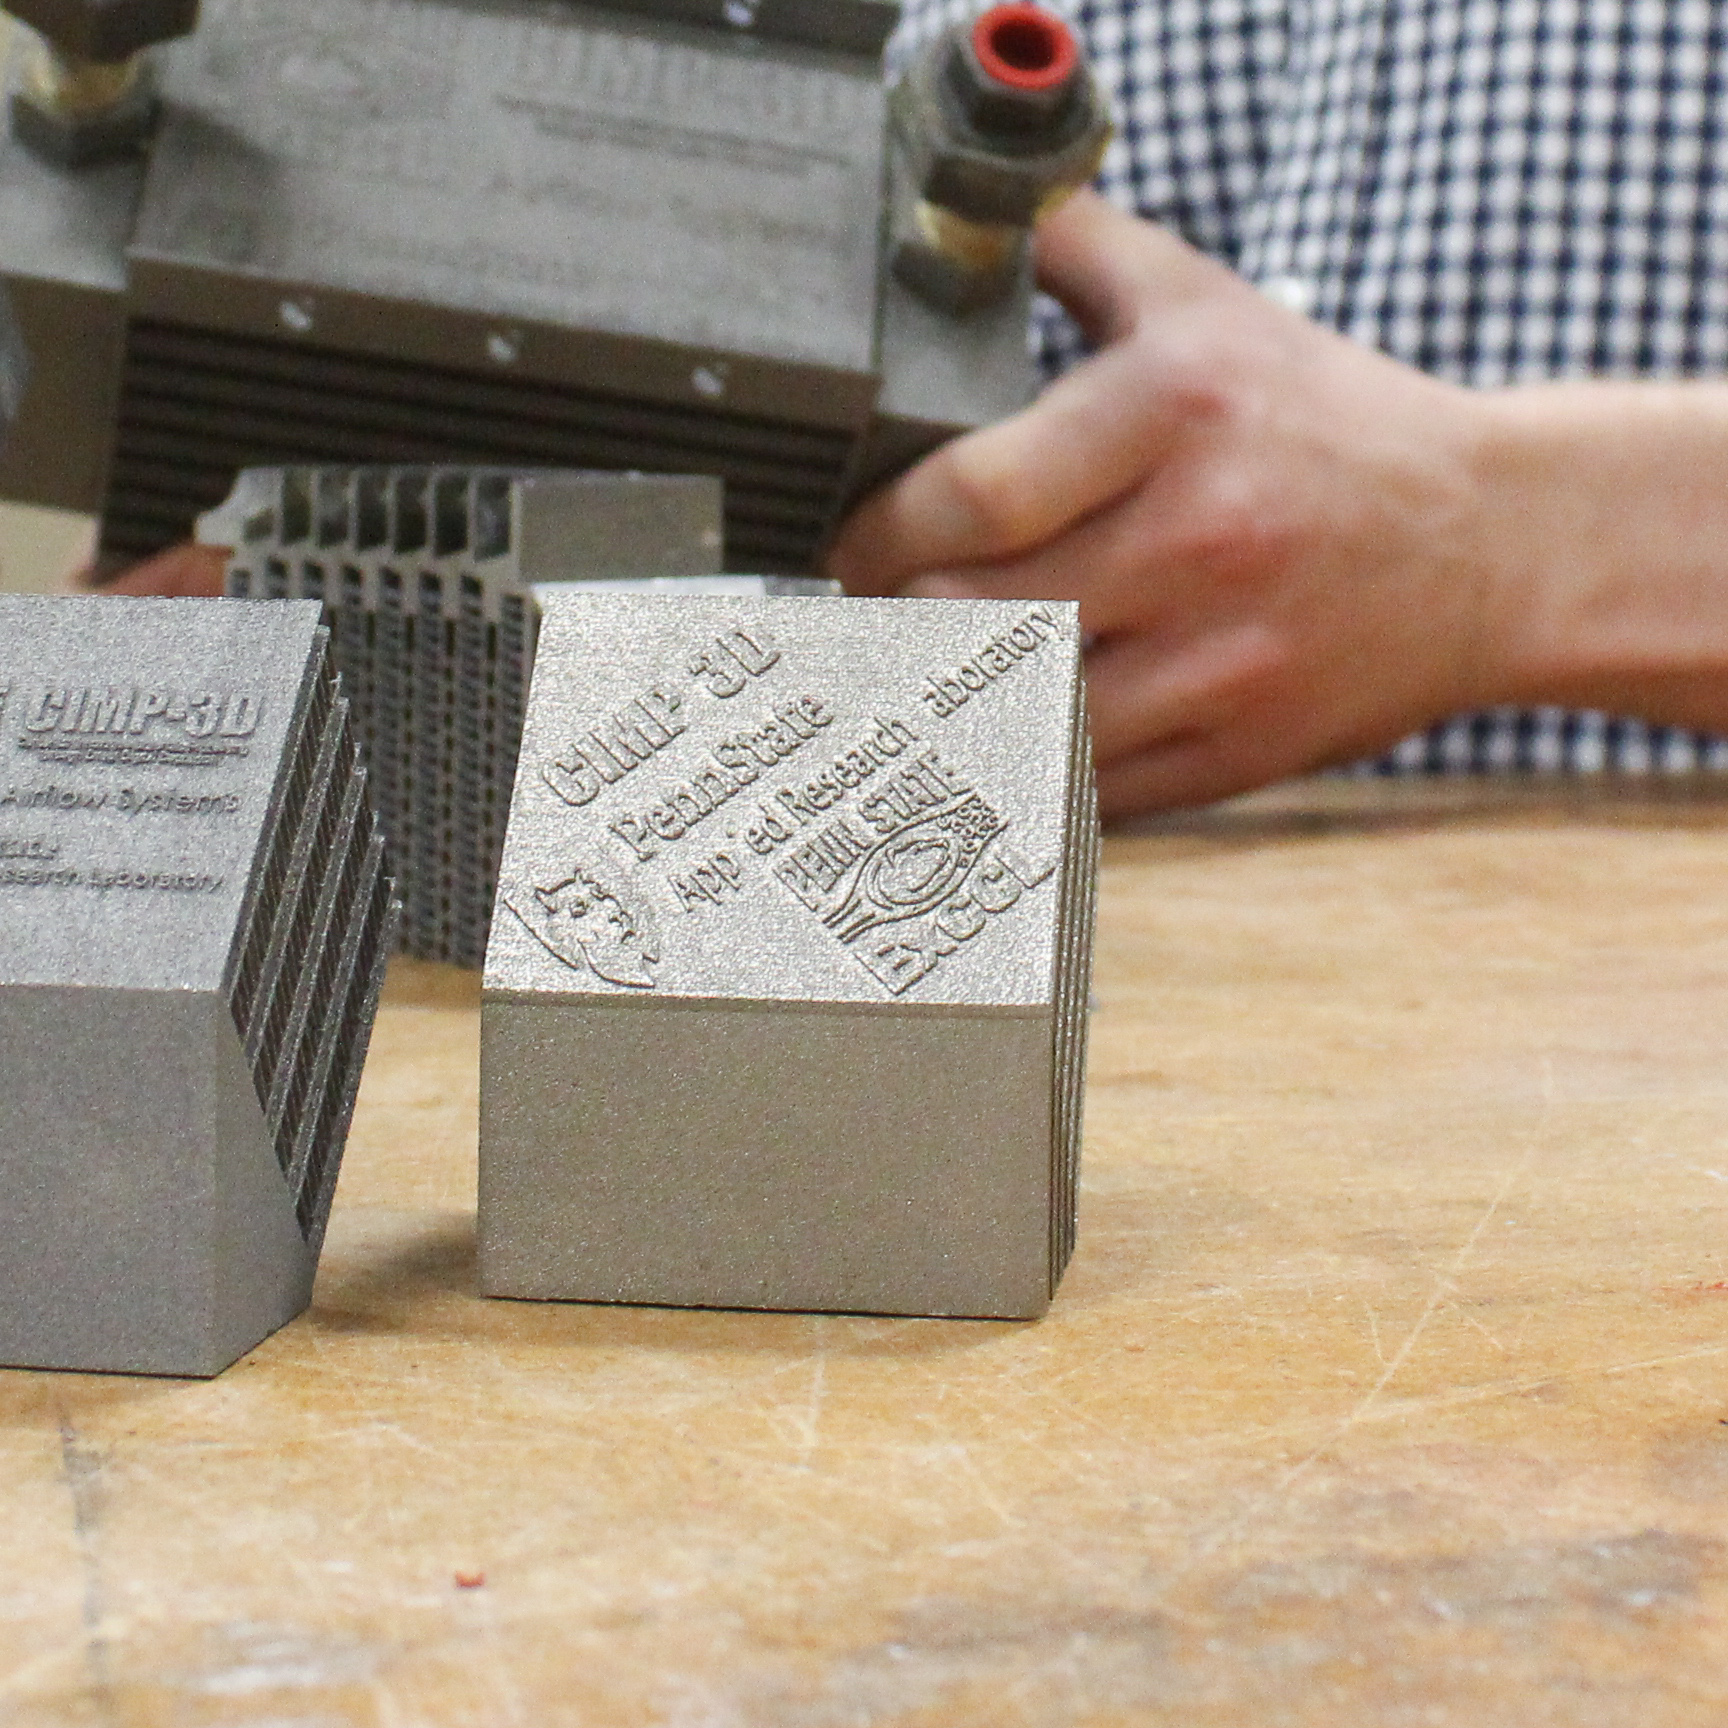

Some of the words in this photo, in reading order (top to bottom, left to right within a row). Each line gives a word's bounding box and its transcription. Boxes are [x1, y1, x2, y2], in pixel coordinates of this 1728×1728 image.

[22, 687, 265, 740] CIMP-3D
[118, 784, 241, 820] Systems
[607, 693, 836, 863] PennState
[774, 714, 920, 826] Research
[772, 818, 872, 912] PENN
[856, 752, 971, 834] STATE
[86, 867, 226, 895] Laboratory
